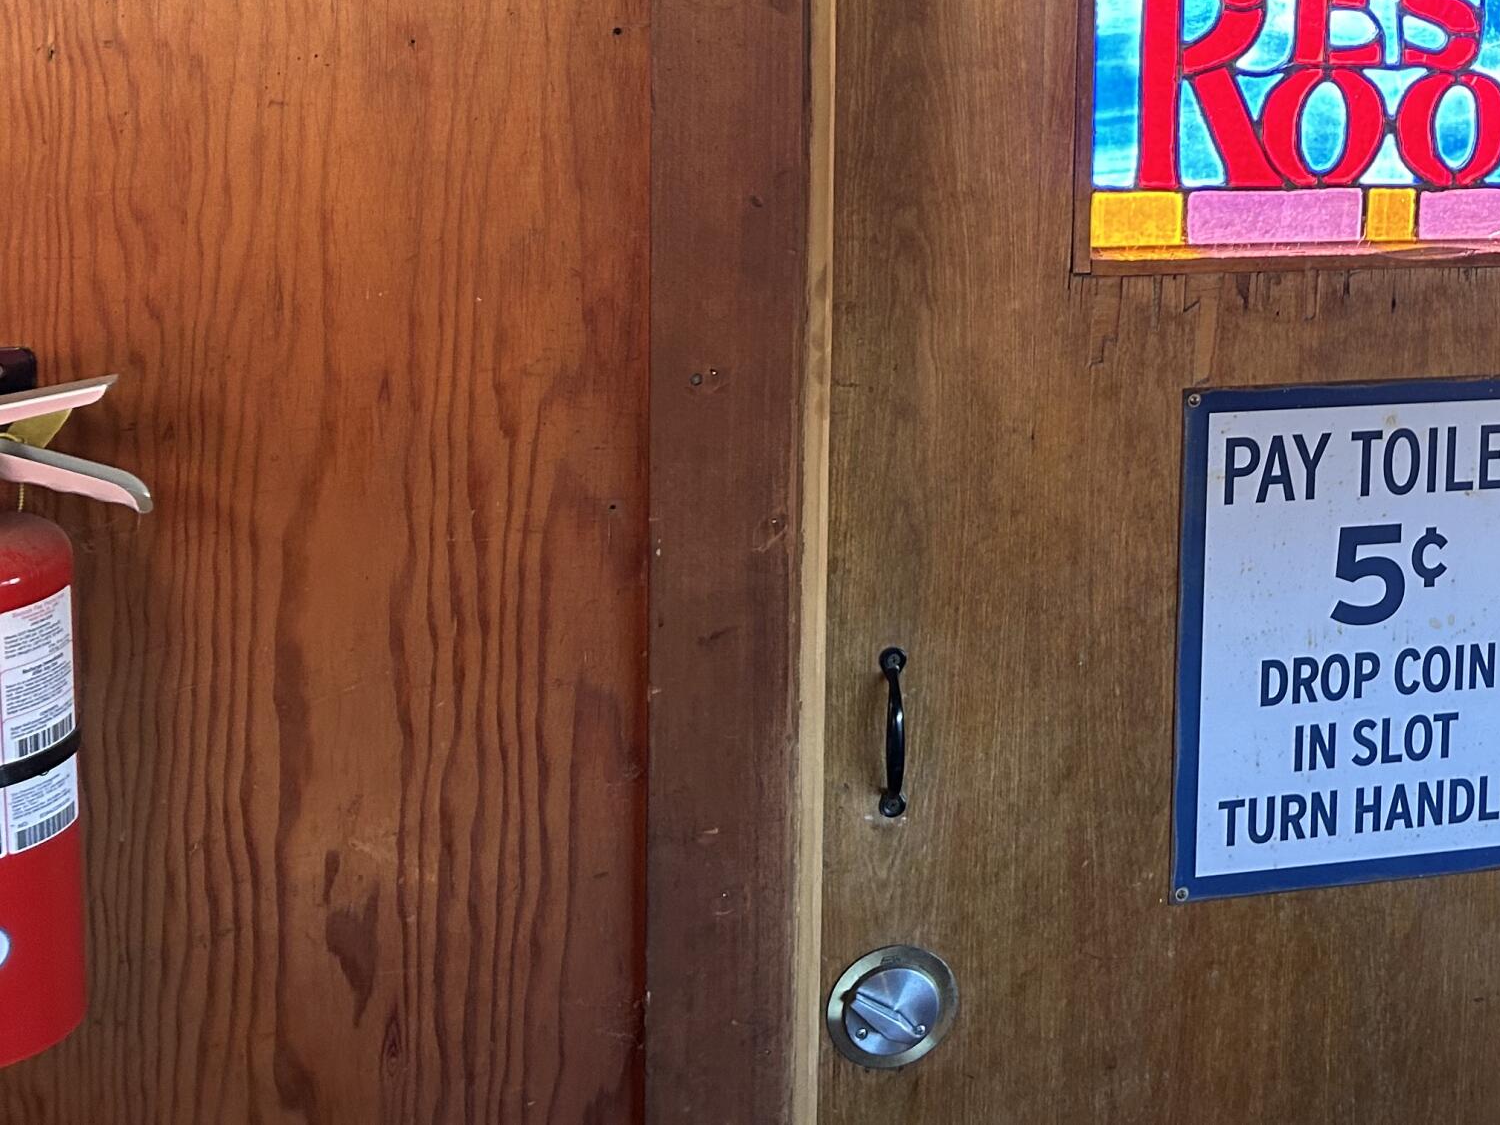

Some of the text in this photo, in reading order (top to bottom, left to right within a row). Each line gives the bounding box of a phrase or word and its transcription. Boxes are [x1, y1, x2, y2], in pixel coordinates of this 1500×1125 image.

[1223, 432, 1331, 505] PAY
[1330, 523, 1448, 625] 5¢
[1260, 642, 1496, 707] DROP COIN
[1294, 712, 1459, 772] IN SLOT
[1219, 790, 1338, 847] TURN
